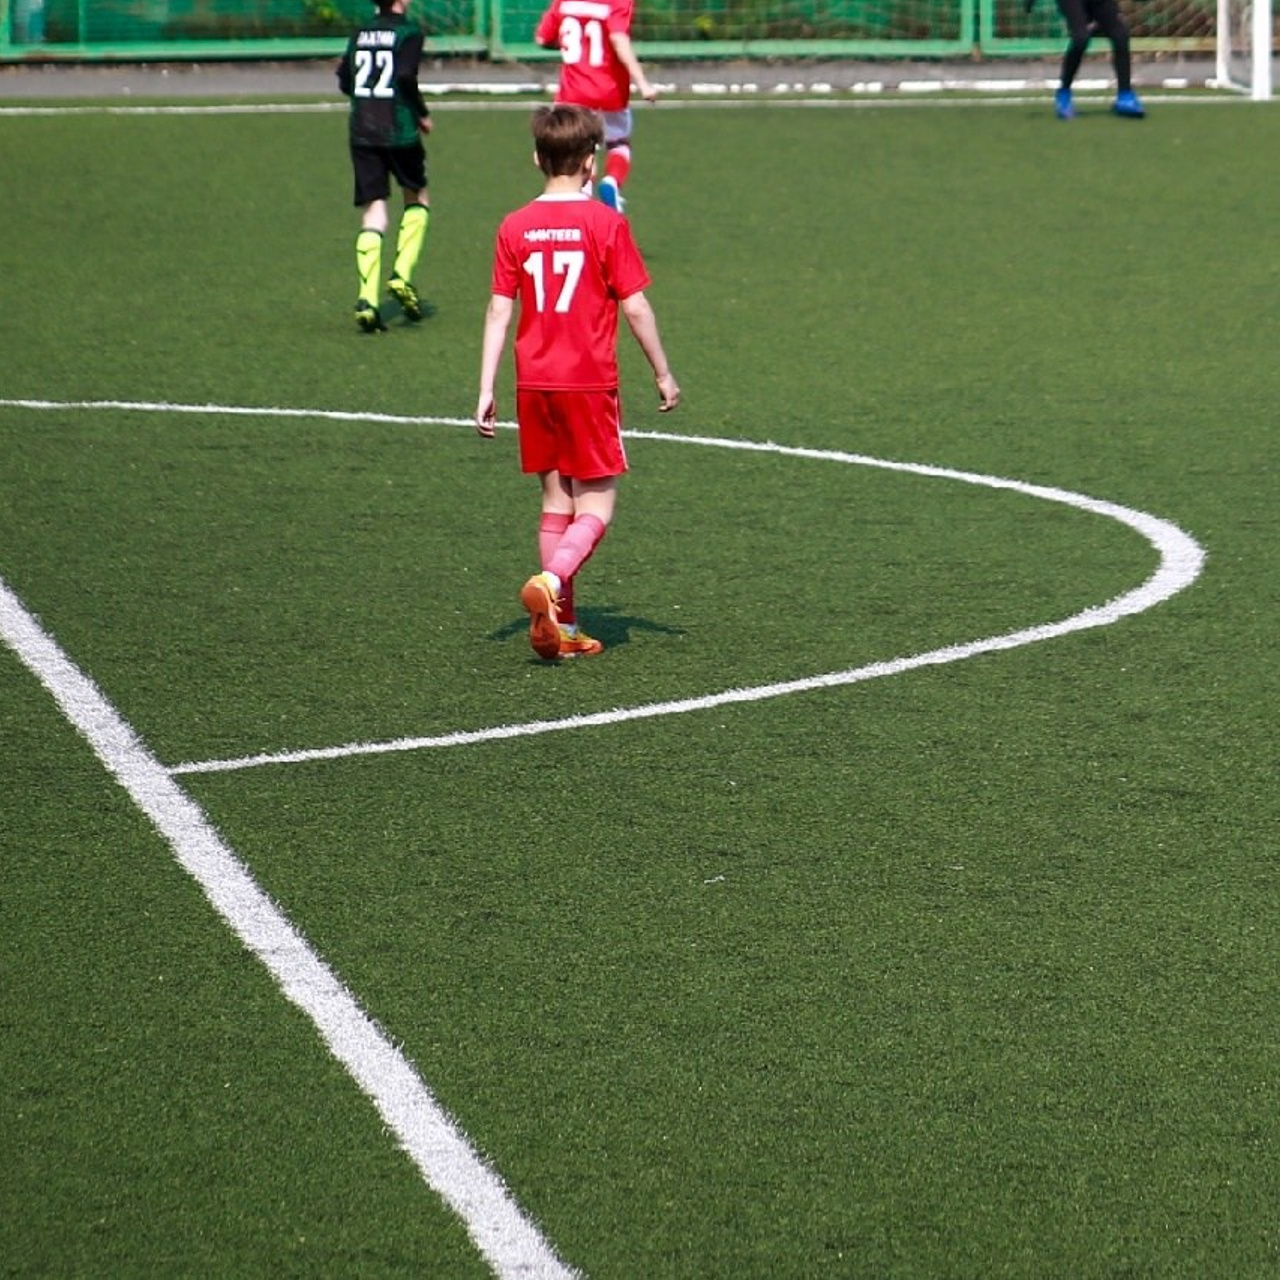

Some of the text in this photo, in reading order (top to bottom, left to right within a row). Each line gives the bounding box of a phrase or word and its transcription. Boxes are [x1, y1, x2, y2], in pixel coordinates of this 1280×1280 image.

[559, 15, 604, 68] 31
[354, 50, 395, 98] 22
[522, 251, 585, 314] 17
